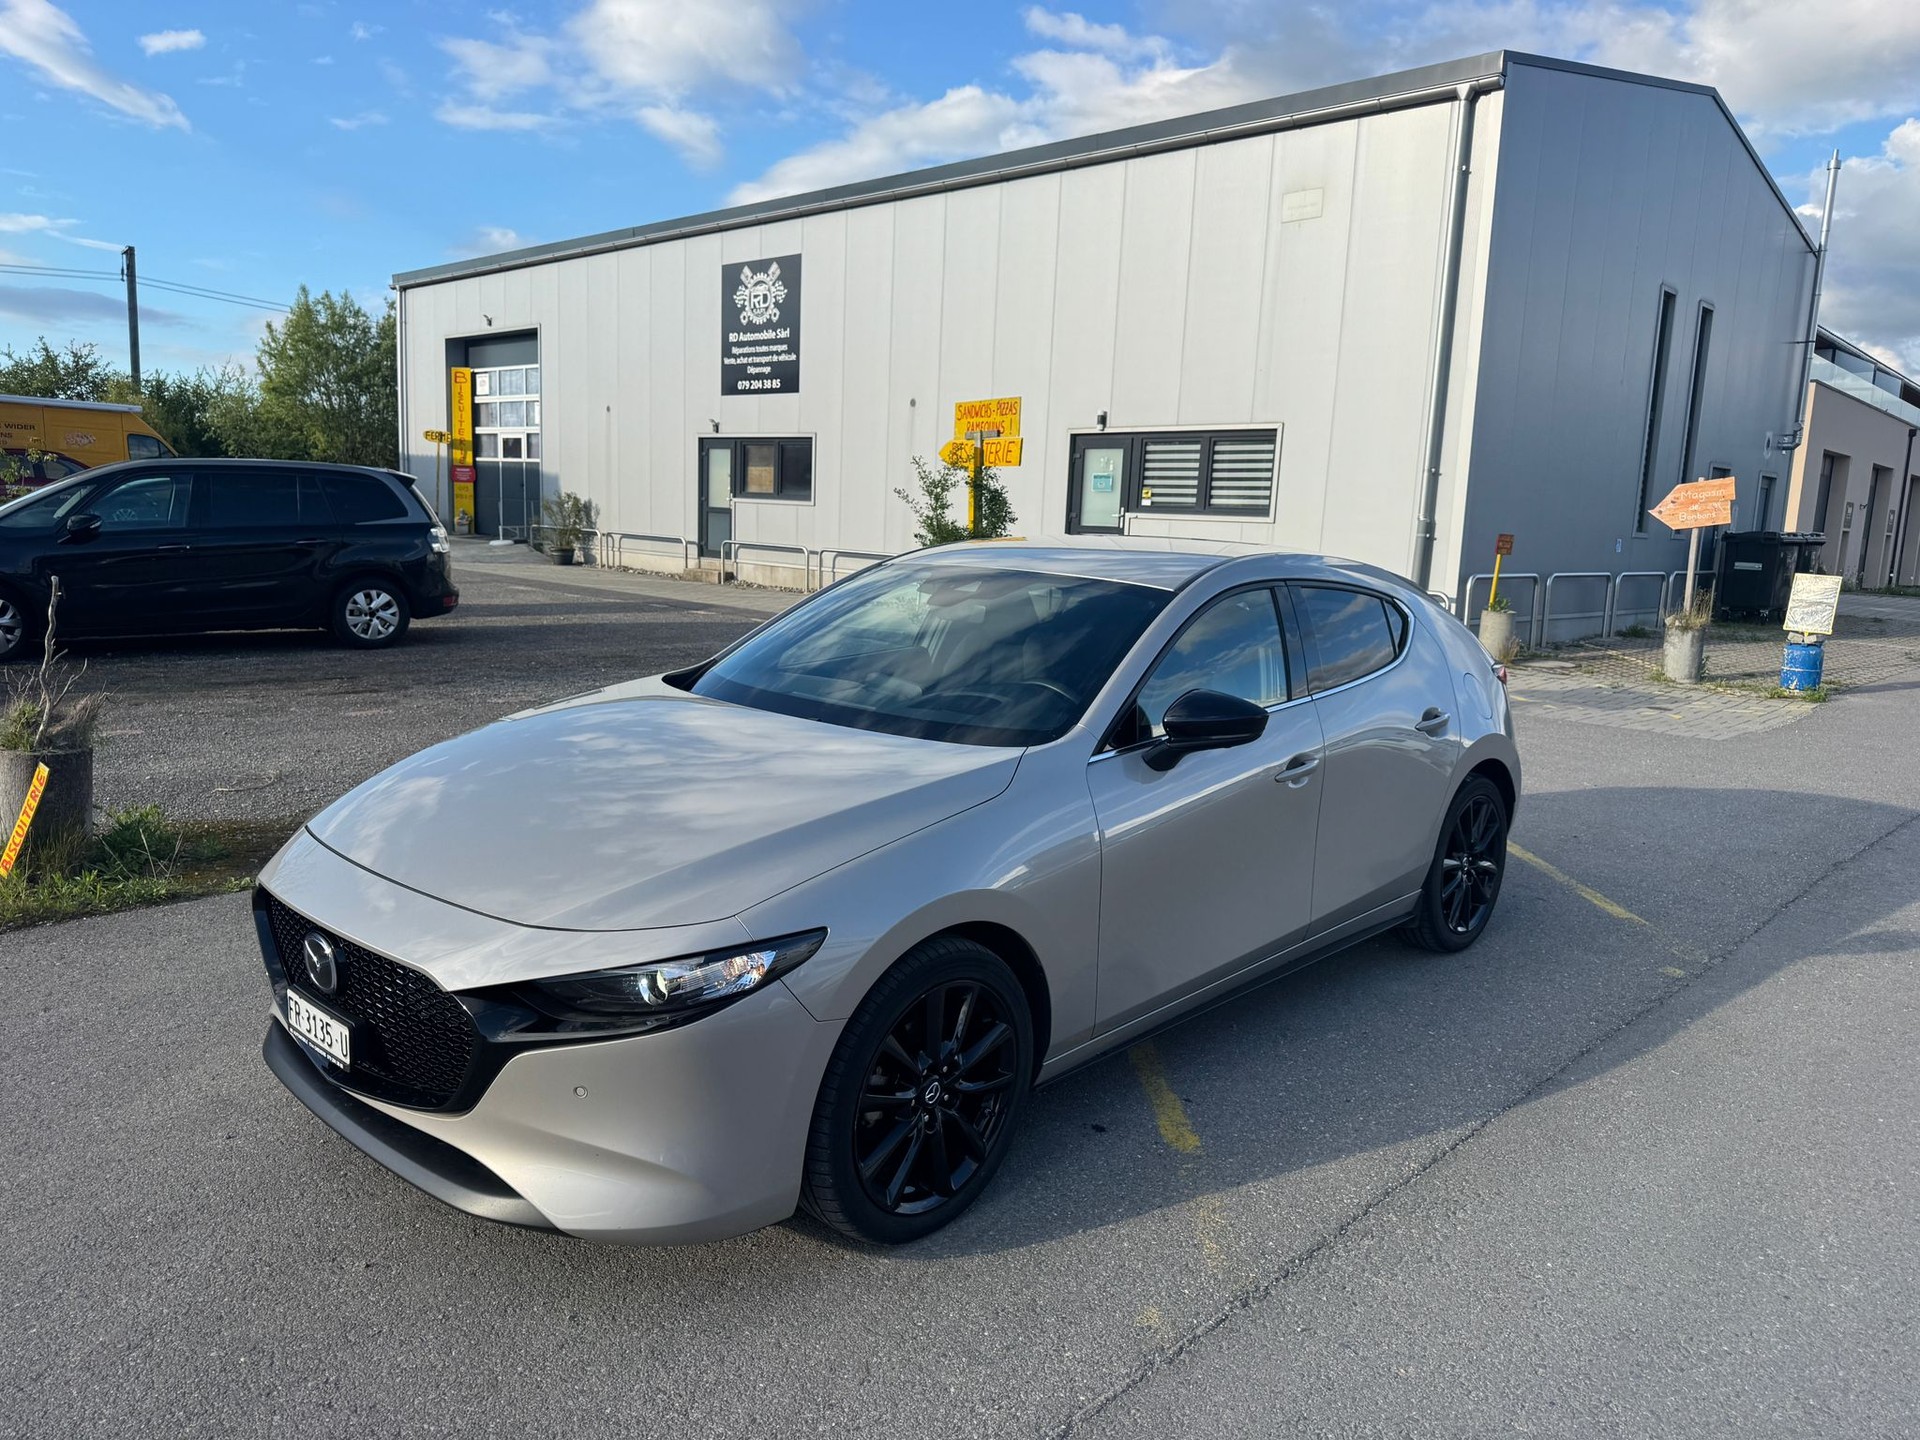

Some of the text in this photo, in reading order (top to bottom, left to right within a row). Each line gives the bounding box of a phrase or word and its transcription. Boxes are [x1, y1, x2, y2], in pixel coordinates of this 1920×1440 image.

[750, 291, 771, 309] RD
[729, 332, 738, 342] RD
[739, 330, 776, 341] Automobile
[737, 380, 750, 390] 079
[750, 379, 763, 390] 204
[763, 379, 772, 389] 38
[4, 423, 36, 431] WIDER
[1680, 488, 1726, 502] Magasin
[1679, 511, 1716, 522] Bonbons
[1, 769, 45, 872] BISCUITERIE
